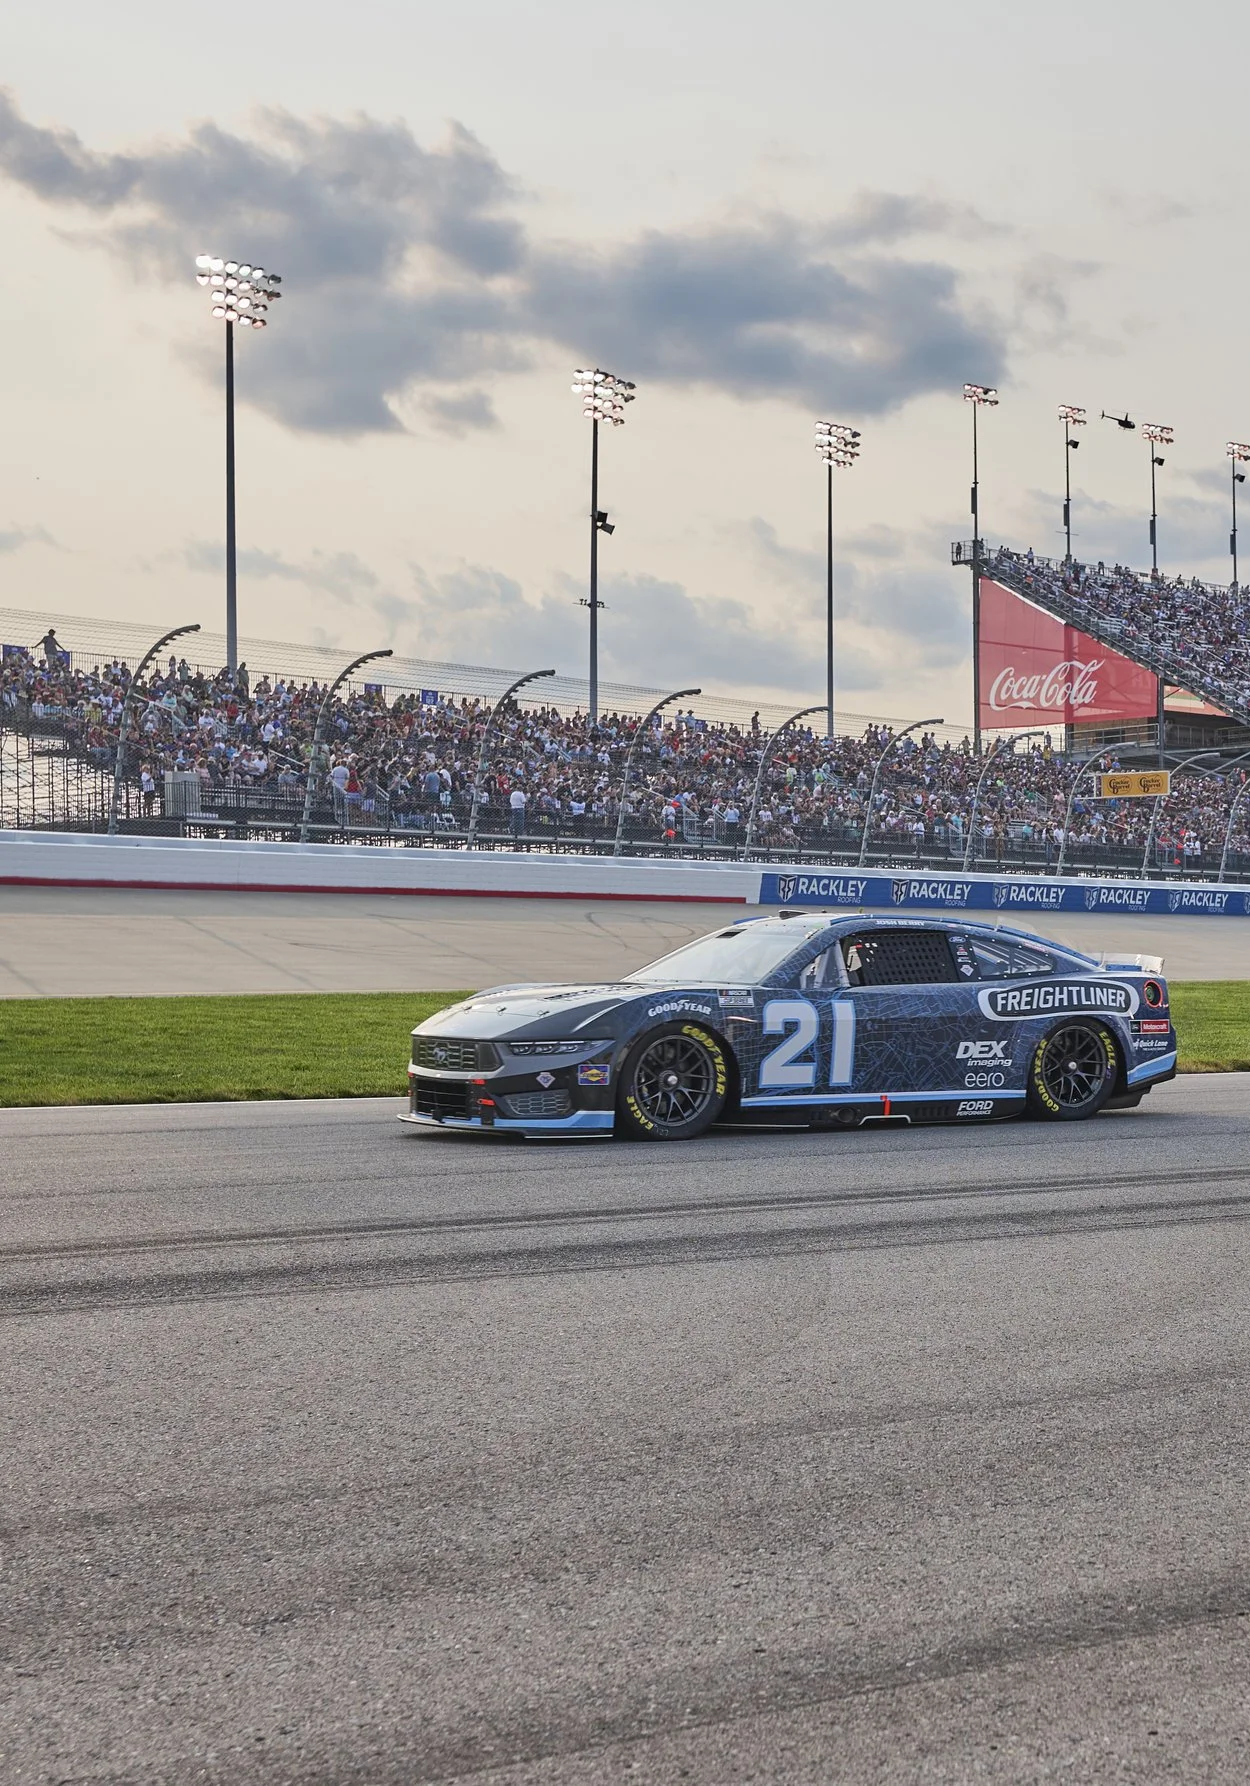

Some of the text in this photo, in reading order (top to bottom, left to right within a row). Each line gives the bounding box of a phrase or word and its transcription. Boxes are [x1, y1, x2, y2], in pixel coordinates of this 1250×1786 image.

[989, 659, 1105, 711] Coca-Cola
[1112, 784, 1130, 795] Barrel
[1143, 782, 1161, 793] Barrel
[798, 878, 867, 897] RACKLEY
[909, 881, 972, 900] RACKLEY
[1009, 886, 1065, 903] RACKLEY
[838, 896, 861, 904] ROOFING
[945, 899, 966, 907] ROOFING
[1099, 889, 1151, 905] RACKLEY
[1182, 892, 1228, 907] RACKLEY
[996, 986, 1126, 1012] FREIGHTLINER
[647, 999, 712, 1017] GOODYEAR
[759, 999, 856, 1088] 21
[955, 1040, 1008, 1059] DEX
[1099, 1031, 1116, 1067] EAGLE
[1139, 1040, 1154, 1048] Quick
[682, 1025, 726, 1096] GOODYEAR
[967, 1058, 1013, 1067] imaging
[965, 1072, 1005, 1088] eero
[1034, 1039, 1060, 1112] GOODYEAR
[626, 1095, 654, 1130] EAGLE
[958, 1100, 994, 1111] FORD
